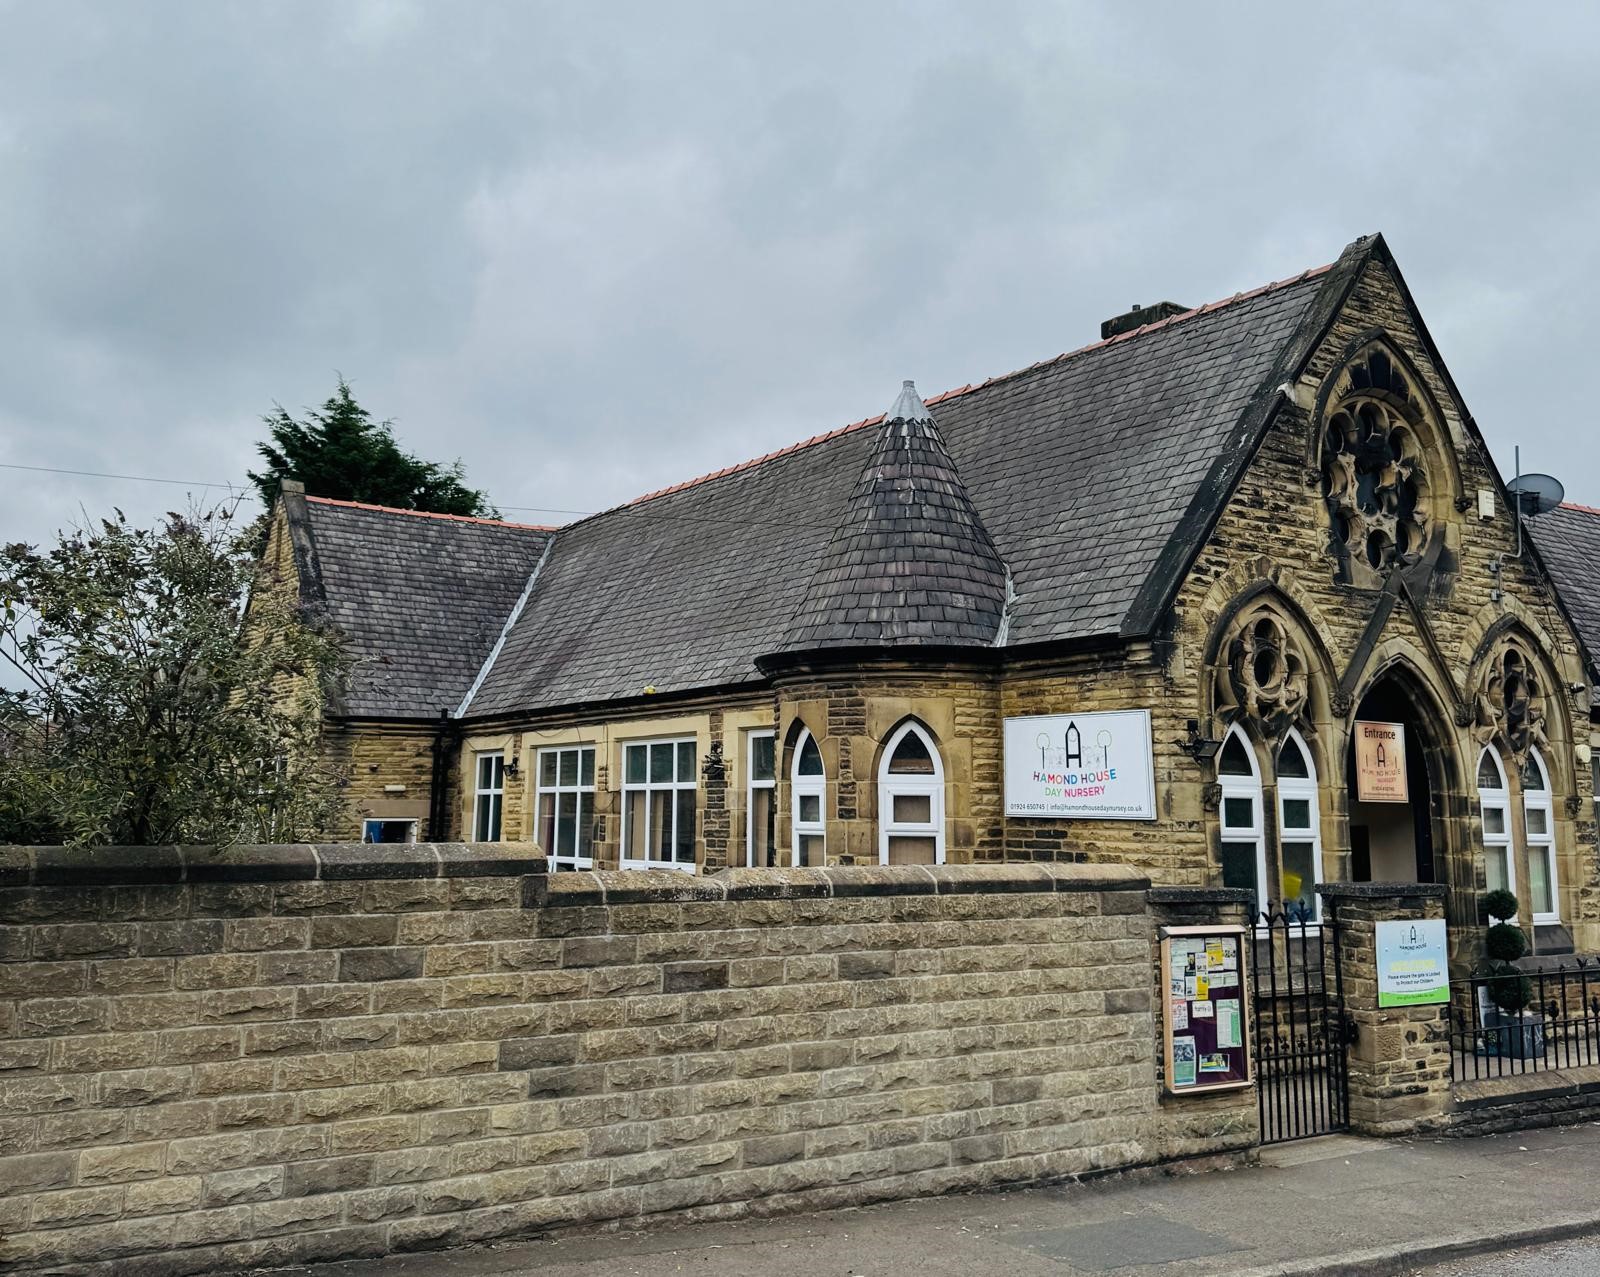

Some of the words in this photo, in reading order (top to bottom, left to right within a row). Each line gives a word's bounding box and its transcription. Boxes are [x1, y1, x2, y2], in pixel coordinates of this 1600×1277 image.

[1364, 727, 1396, 740] Entrance
[1033, 771, 1078, 785] HAMOND
[1080, 768, 1117, 782] HOUSE
[1045, 787, 1062, 796] DAY
[1064, 786, 1106, 798] NURSERY
